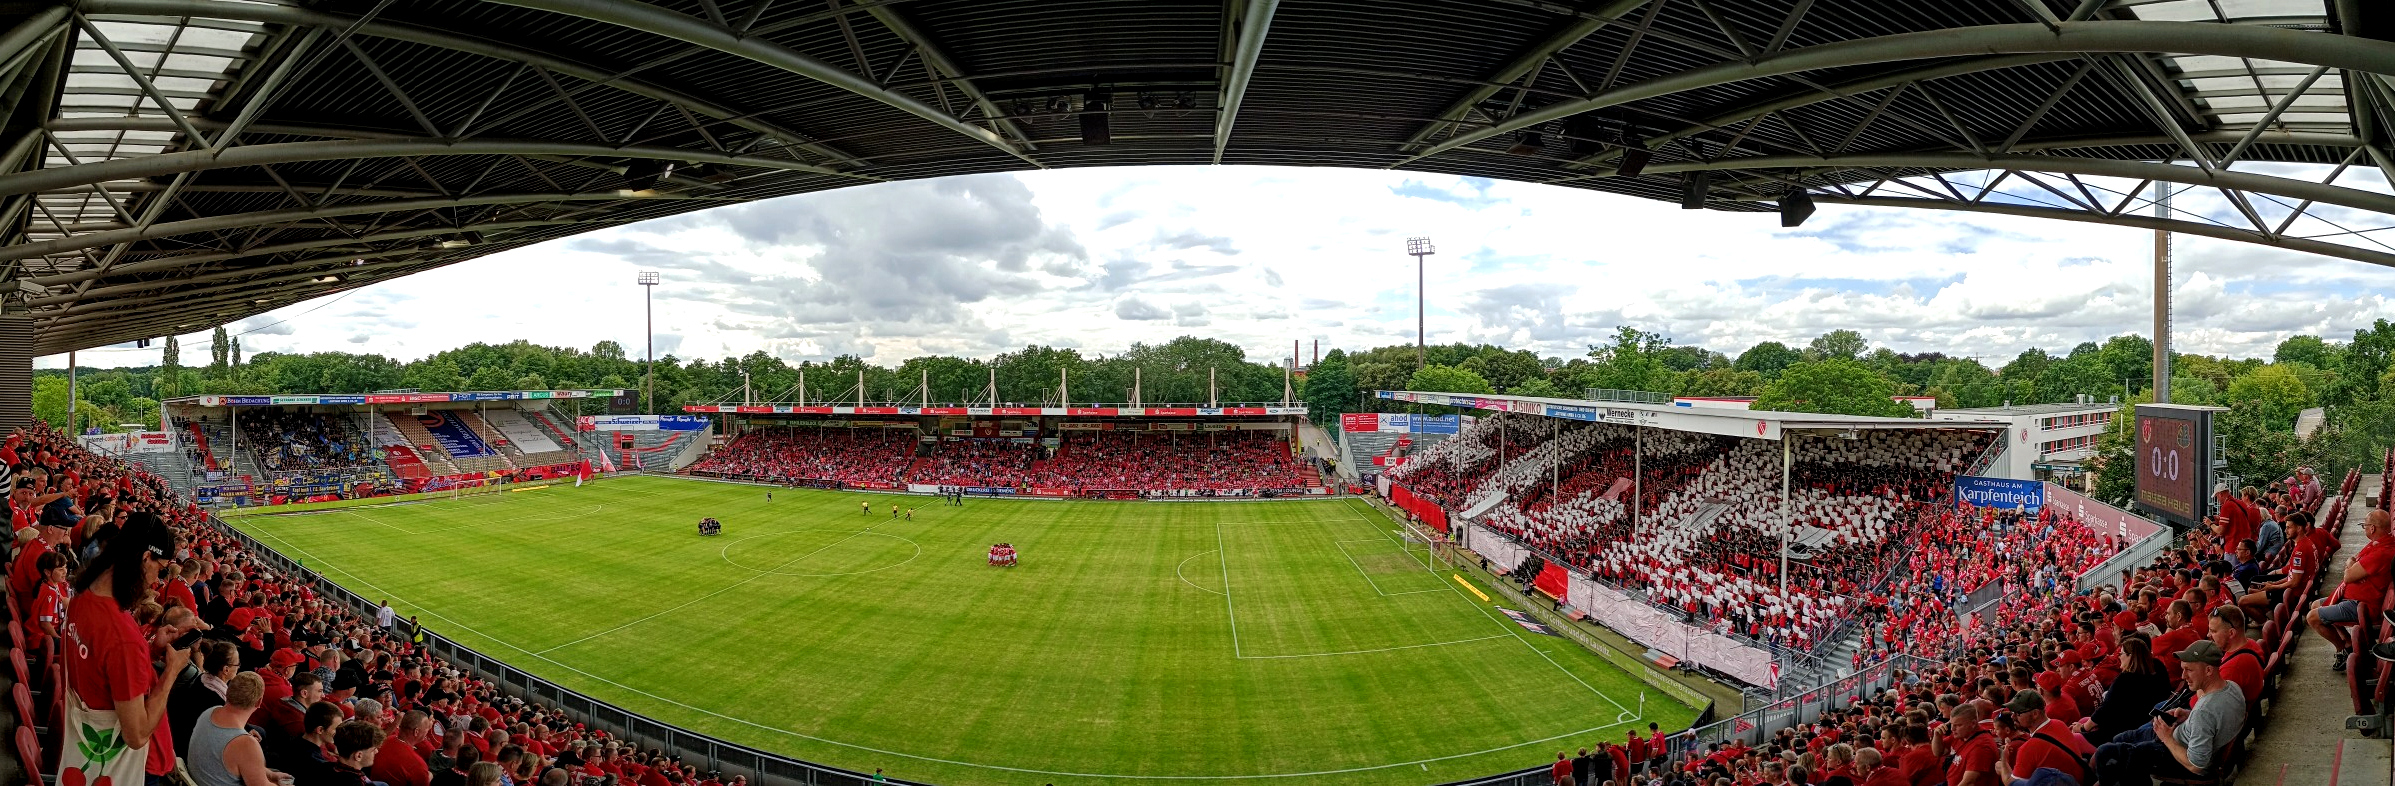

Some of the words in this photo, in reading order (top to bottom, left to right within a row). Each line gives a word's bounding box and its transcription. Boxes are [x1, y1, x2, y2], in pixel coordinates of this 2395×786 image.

[1606, 408, 1634, 418] Wernecke
[2152, 446, 2178, 481] 0:0
[1974, 480, 2010, 488] GASTHAUS
[1958, 486, 2040, 505] Karpfenteich
[2052, 497, 2070, 510] Sparkasse
[2084, 511, 2107, 528] Sparkasse
[1550, 614, 1568, 632] Cottbus
